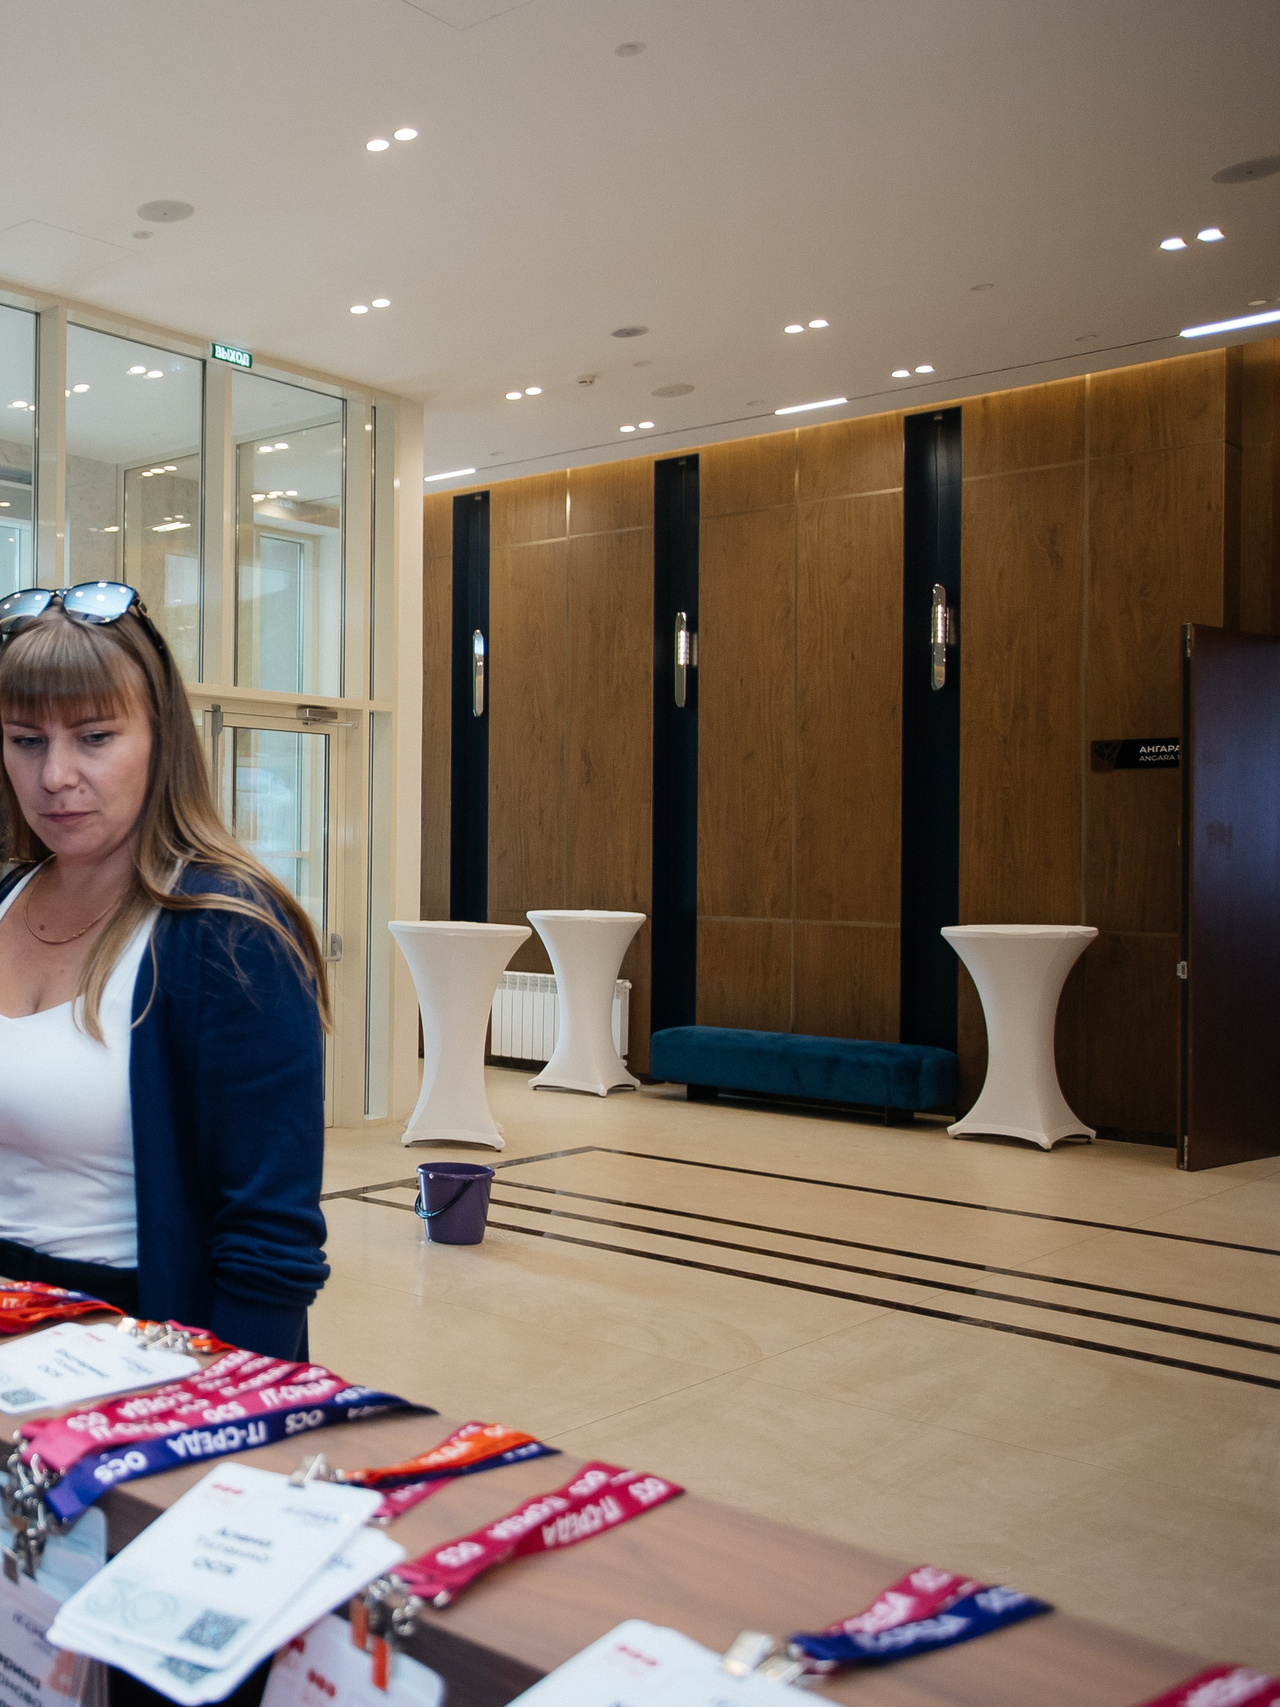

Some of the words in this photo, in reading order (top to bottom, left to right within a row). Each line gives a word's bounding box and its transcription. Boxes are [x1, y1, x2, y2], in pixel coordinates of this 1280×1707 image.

[215, 345, 250, 367] ВЫХОД
[285, 1409, 325, 1435] OCS
[166, 1420, 268, 1458] IT-СРЕДА
[93, 1450, 149, 1484] OCS
